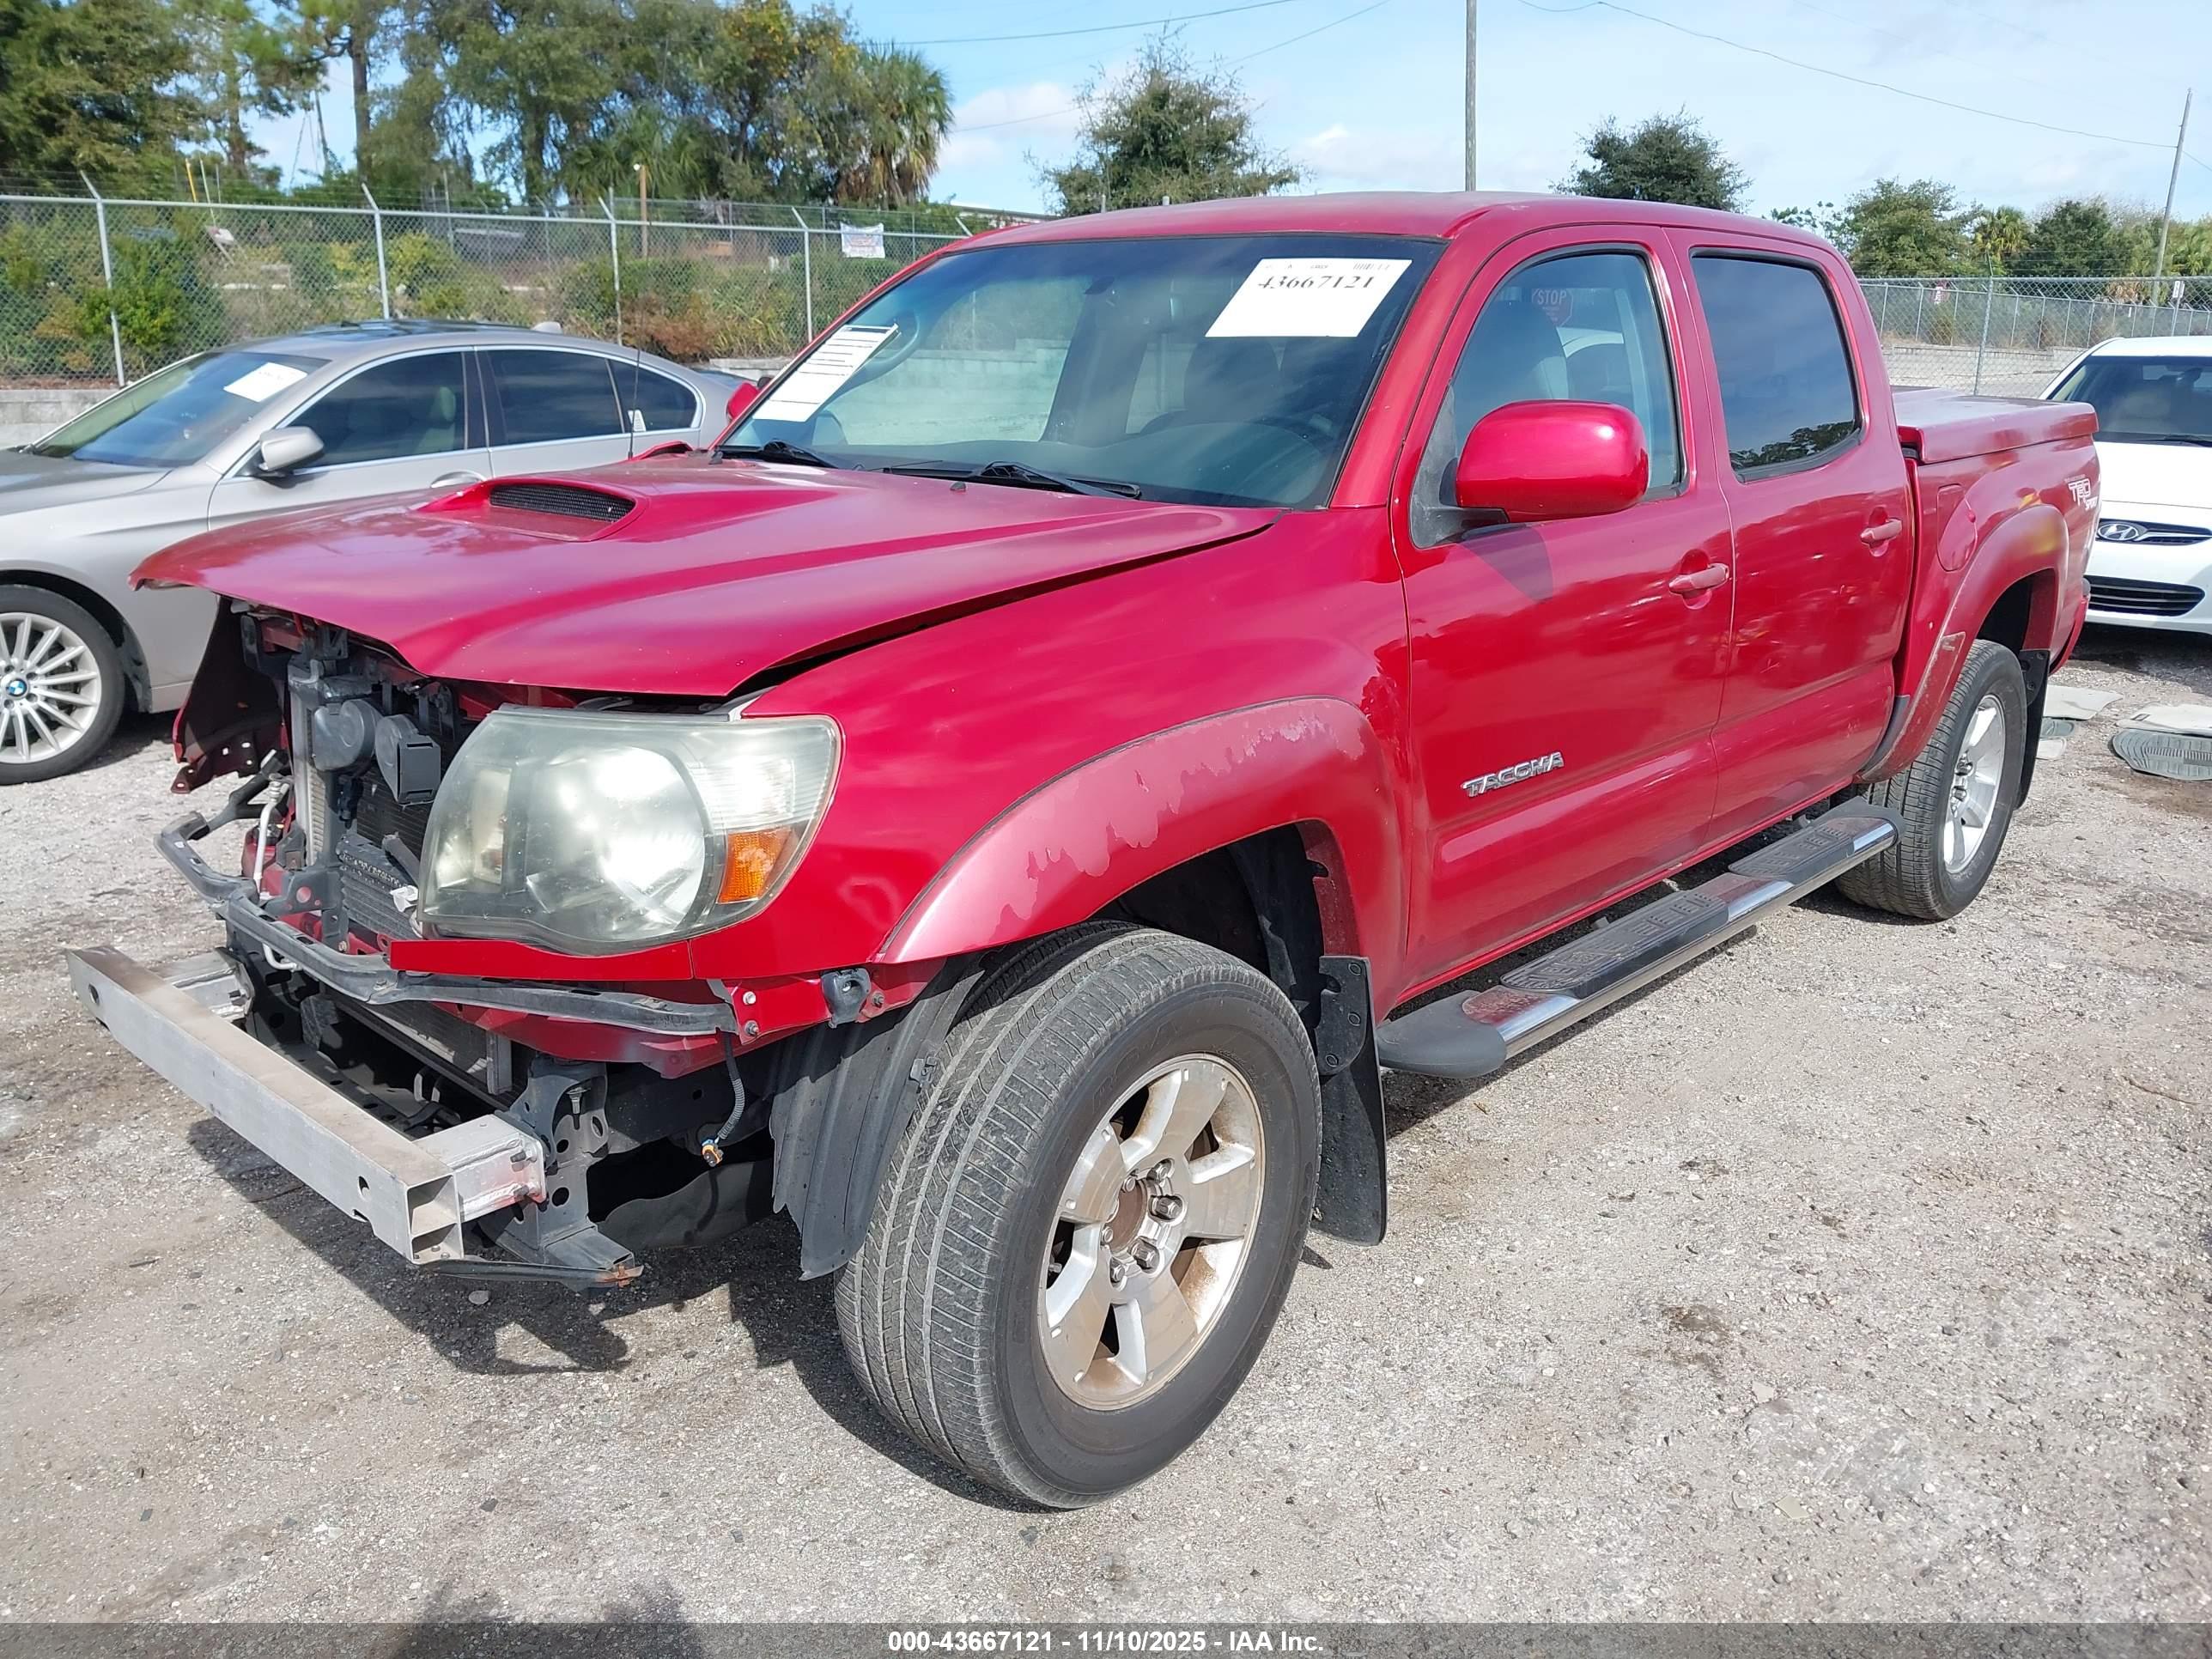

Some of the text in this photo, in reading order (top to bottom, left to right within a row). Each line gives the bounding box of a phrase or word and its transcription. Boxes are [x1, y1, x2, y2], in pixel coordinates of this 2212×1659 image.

[1258, 275, 1376, 289] 43667121
[1537, 289, 1567, 306] STOP
[1462, 751, 1565, 797] TACOMA
